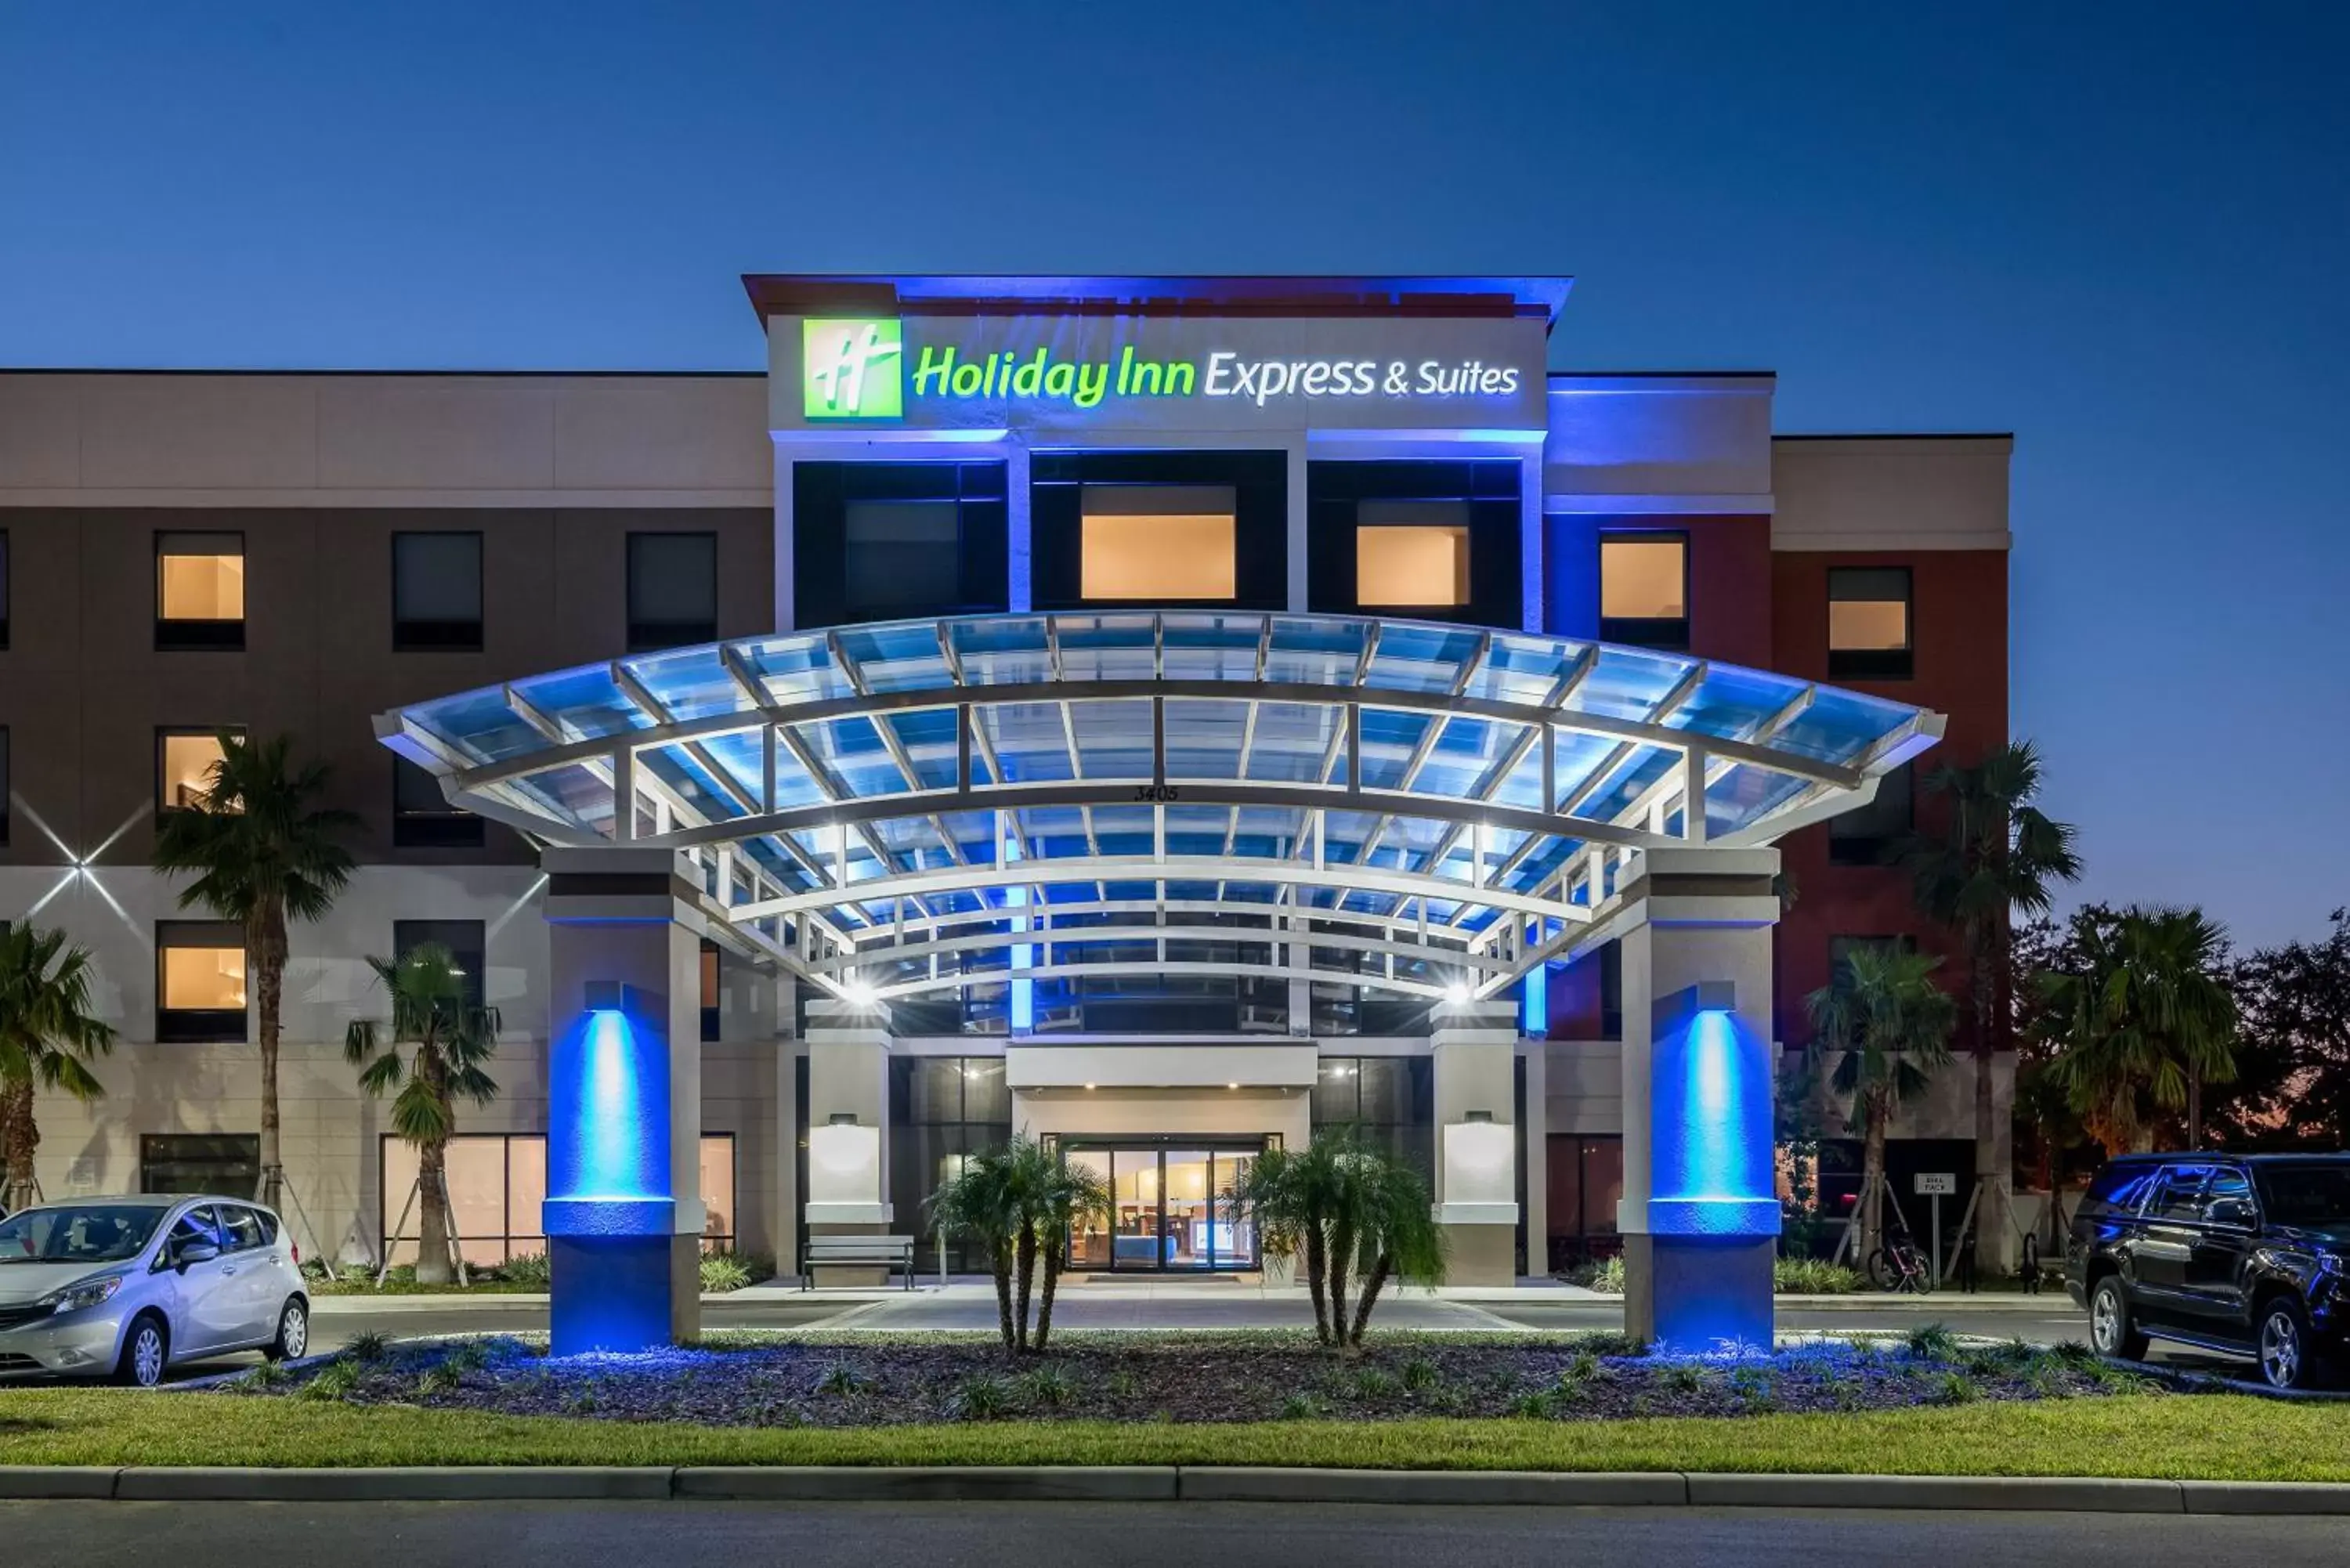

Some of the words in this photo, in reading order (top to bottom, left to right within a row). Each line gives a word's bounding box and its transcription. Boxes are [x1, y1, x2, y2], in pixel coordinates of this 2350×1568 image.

[913, 346, 1109, 407] Holiday
[1117, 346, 1195, 395] Inn
[1204, 352, 1376, 406] Express
[1383, 361, 1408, 394] &
[1415, 361, 1519, 395] Suites
